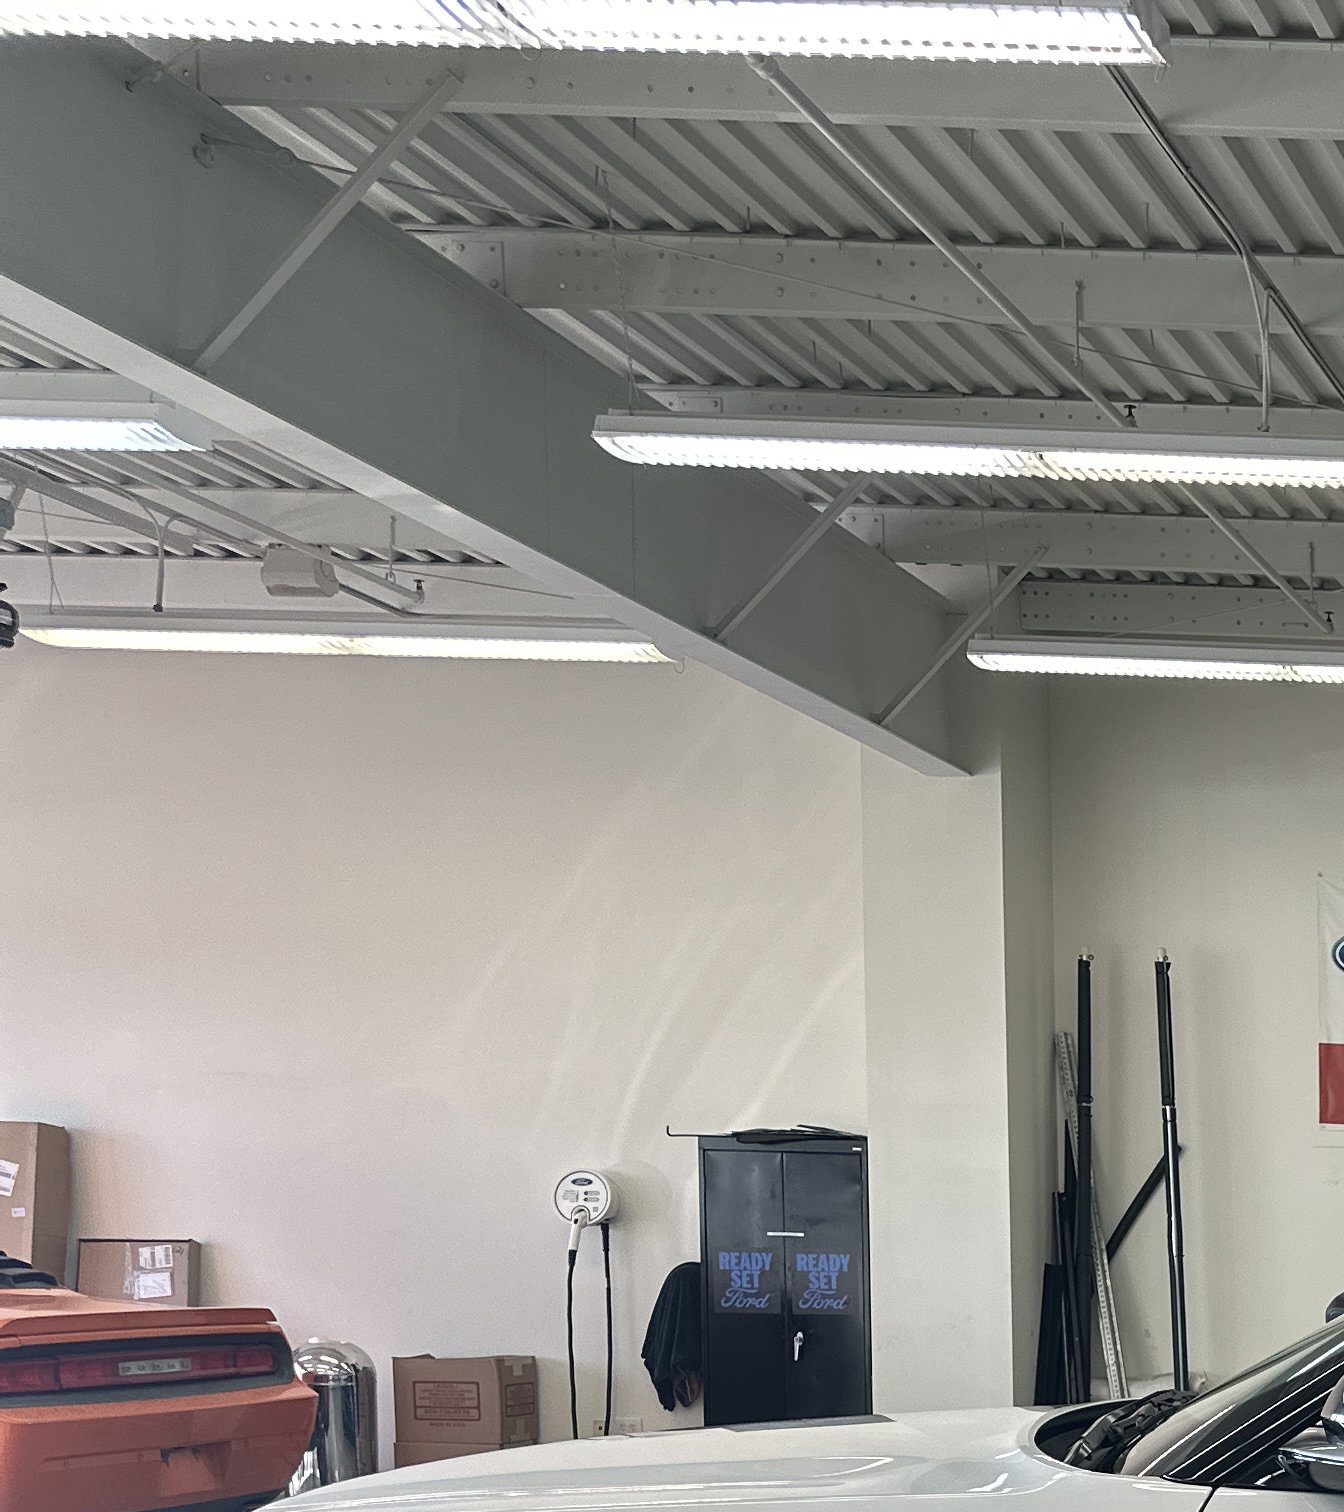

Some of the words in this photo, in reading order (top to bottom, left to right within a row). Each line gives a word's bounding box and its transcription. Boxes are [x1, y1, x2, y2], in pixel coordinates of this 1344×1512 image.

[718, 1251, 773, 1271] READY
[796, 1252, 850, 1272] READY
[730, 1270, 761, 1289] SET
[808, 1271, 839, 1290] SET
[720, 1287, 770, 1309] Ford
[799, 1288, 848, 1310] Ford
